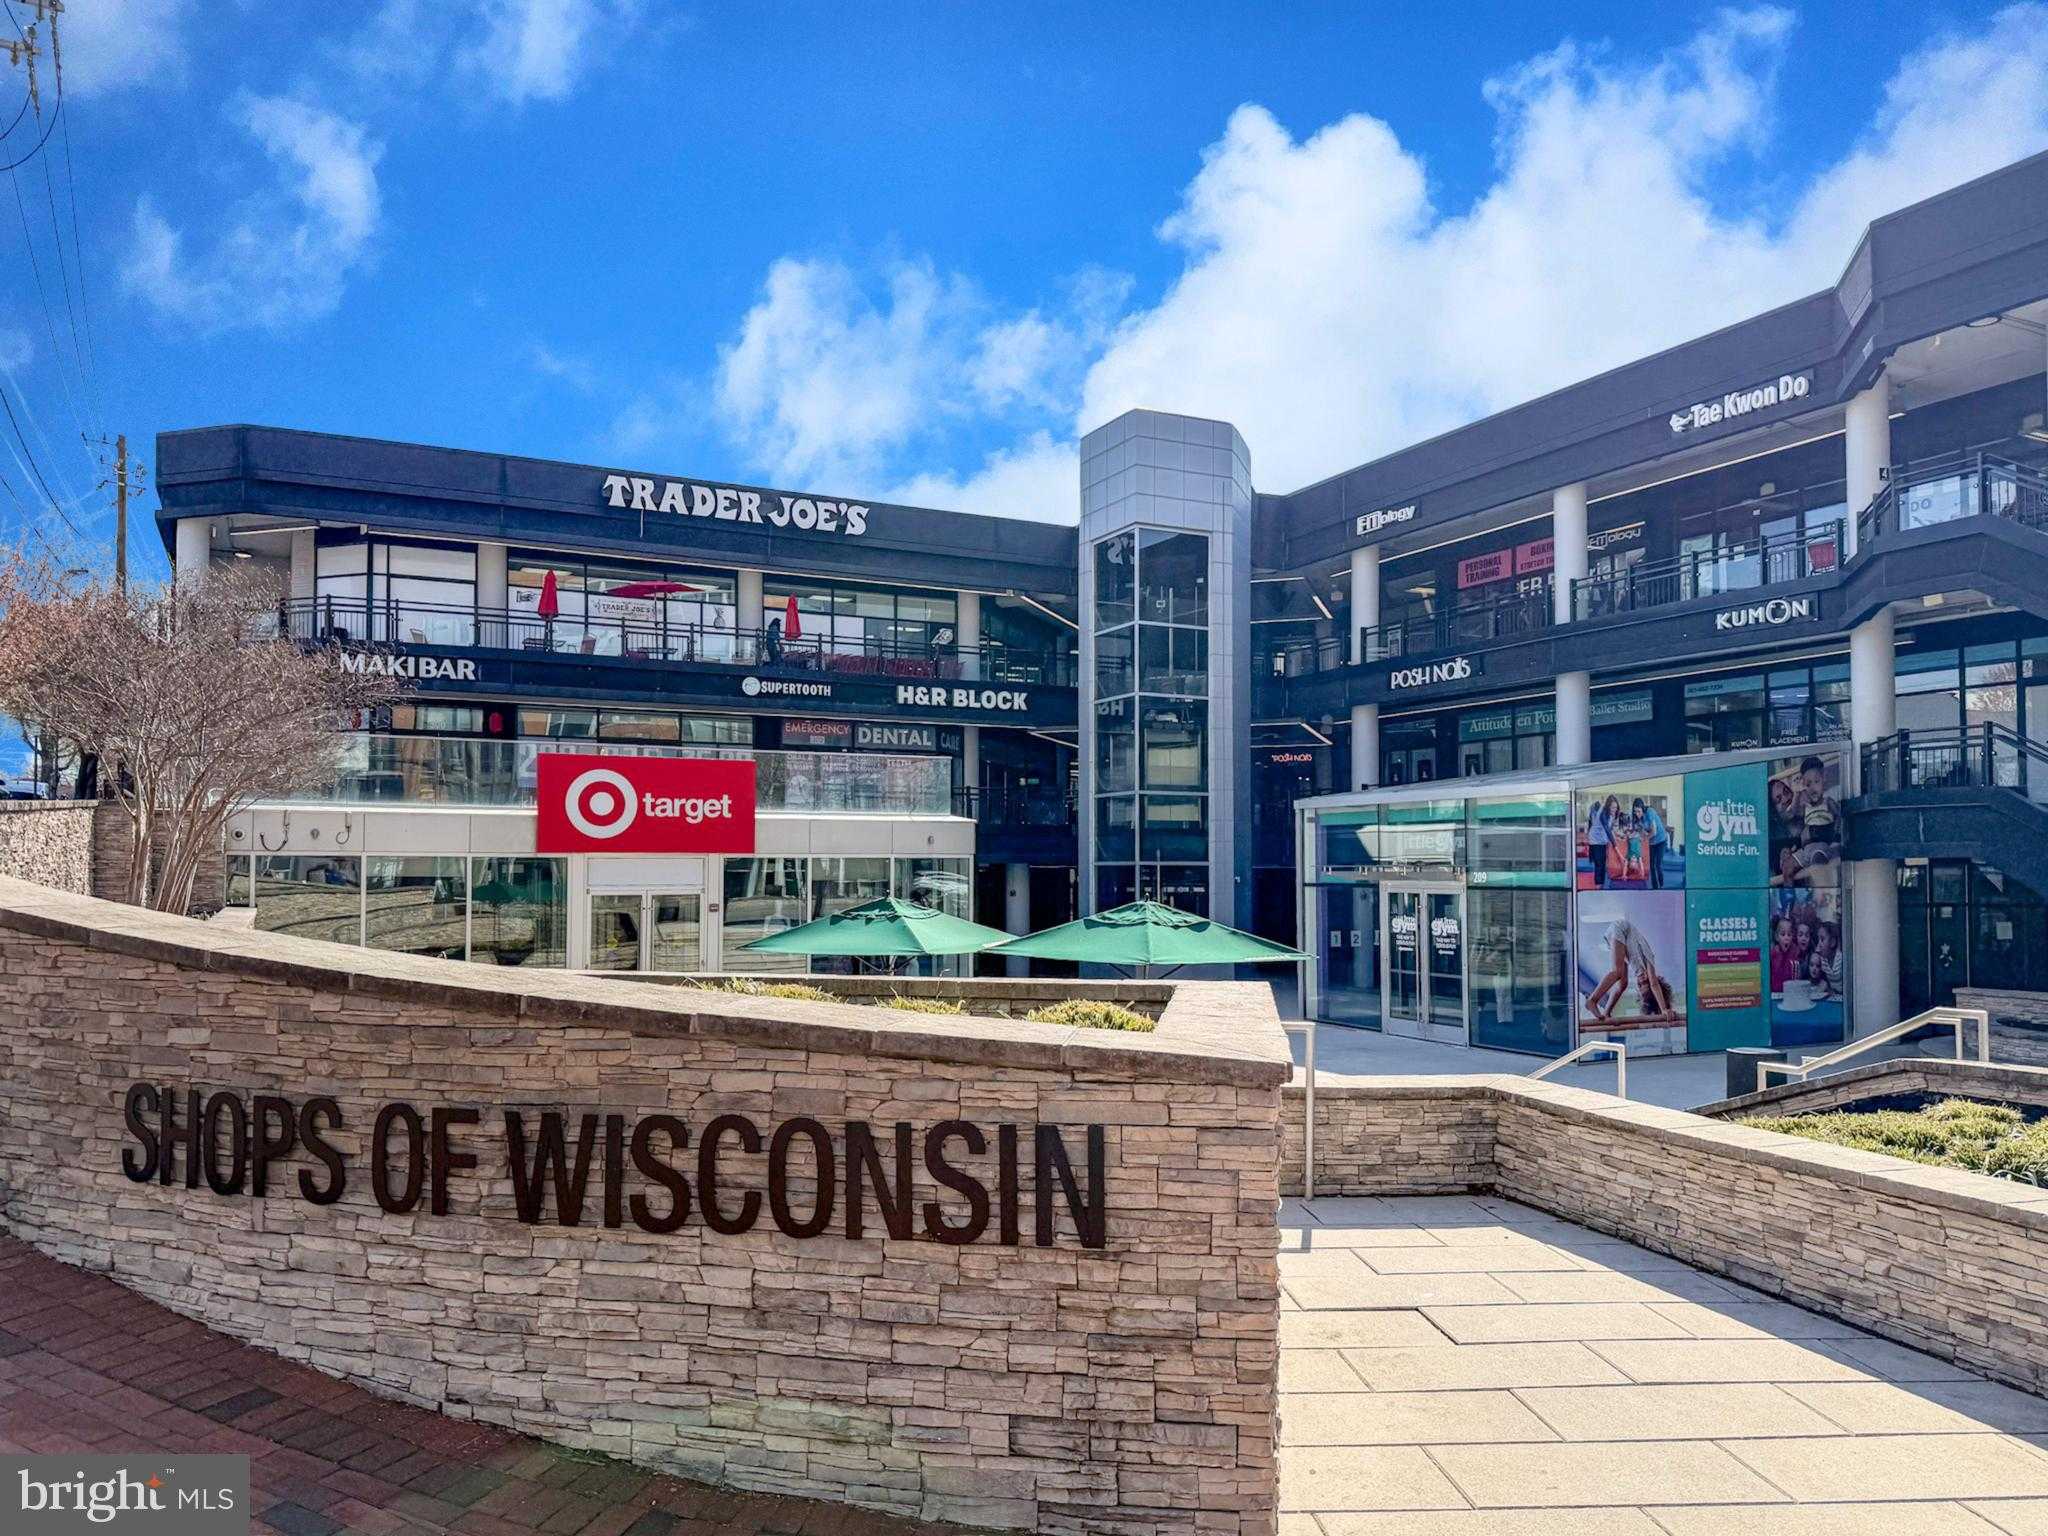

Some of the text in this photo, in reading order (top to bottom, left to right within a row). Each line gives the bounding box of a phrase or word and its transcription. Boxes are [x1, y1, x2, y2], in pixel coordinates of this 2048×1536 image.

[1690, 375, 1809, 427] Tae Kwon Do
[603, 474, 869, 536] TRADER JOE'S
[1716, 599, 1810, 630] KUMON
[1391, 667, 1430, 689] POSH
[761, 681, 832, 697] SUPERTOOTH
[896, 685, 1028, 711] H&R BLOCK
[785, 722, 850, 735] EMERGENCY
[857, 726, 932, 747] DENTAL
[642, 792, 733, 825] target
[1719, 799, 1755, 816] Little
[1696, 805, 1758, 842] gym
[1697, 842, 1760, 856] Serious Fun.
[1472, 871, 1488, 883] 209
[1699, 916, 1758, 930] CLASSES &
[1699, 929, 1758, 942] PROGRAMS
[121, 1082, 1106, 1249] SHOPS OF WISCONSIN
